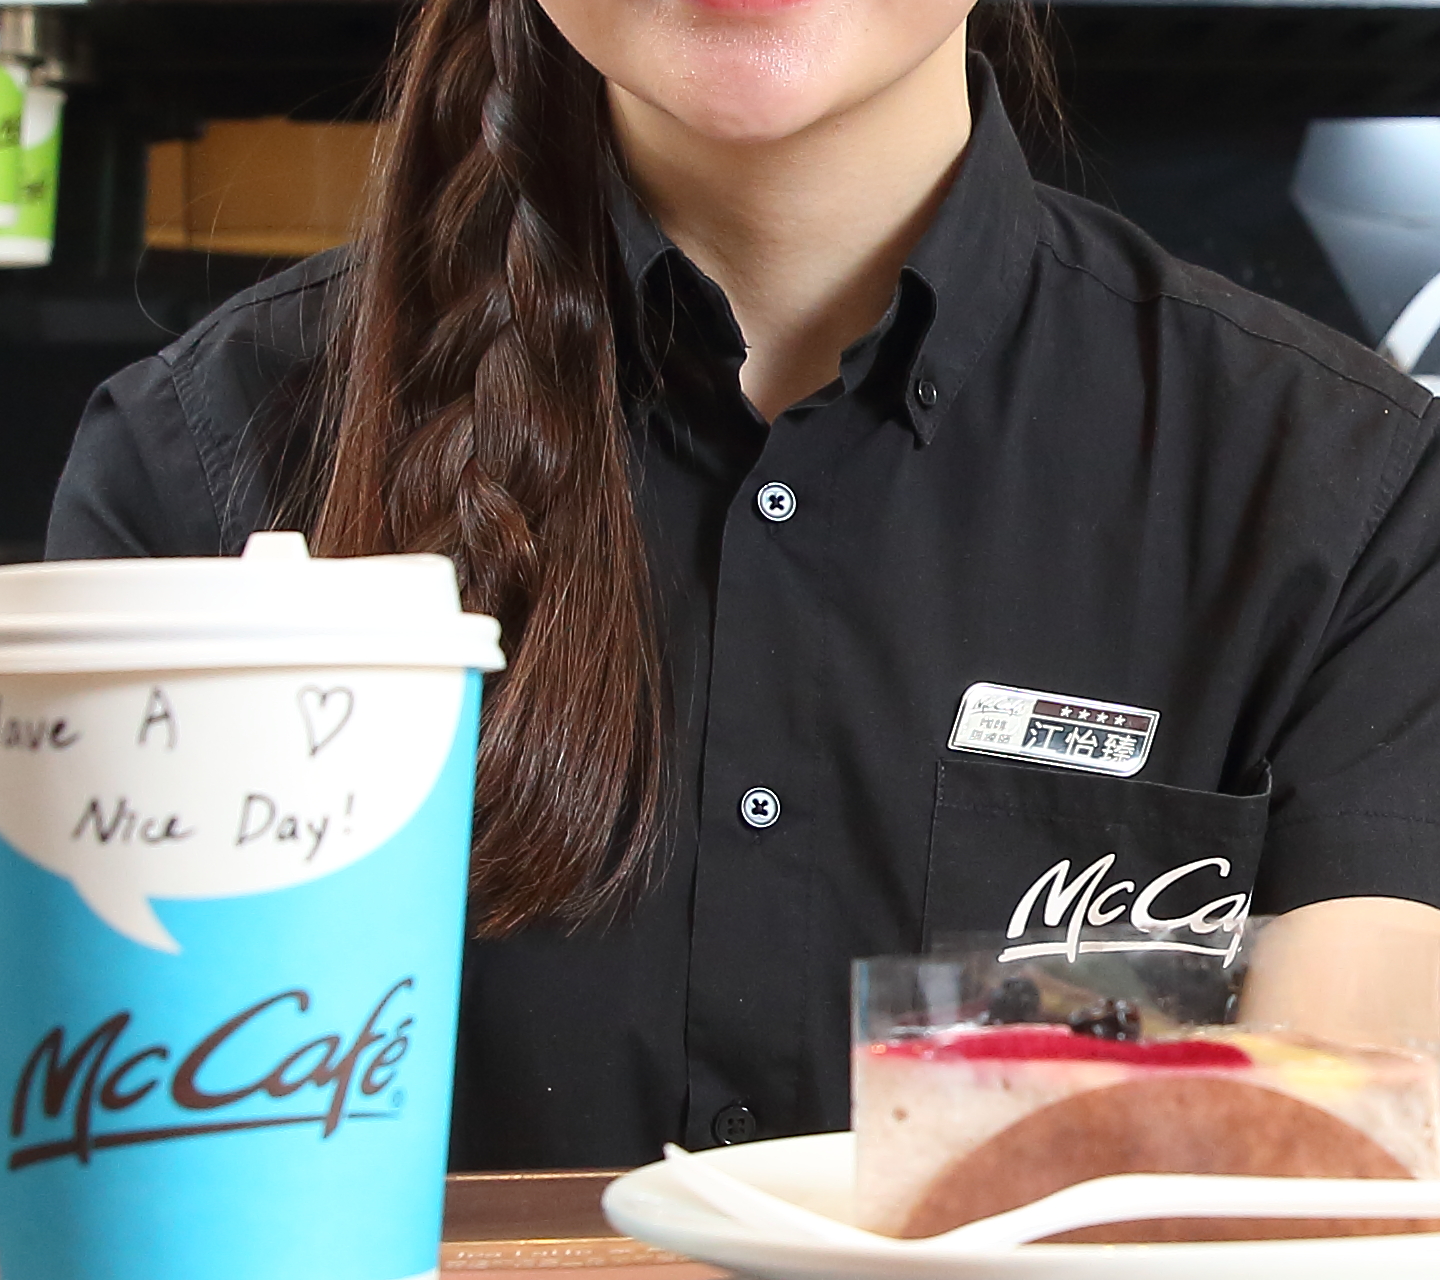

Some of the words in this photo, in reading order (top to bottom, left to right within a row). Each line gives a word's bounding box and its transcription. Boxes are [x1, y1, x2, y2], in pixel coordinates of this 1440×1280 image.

[136, 688, 179, 751] A
[1024, 721, 1138, 762] 江怡臻
[71, 797, 197, 848] Nice
[235, 793, 357, 862] Day!
[8, 975, 415, 1170] McCafé
